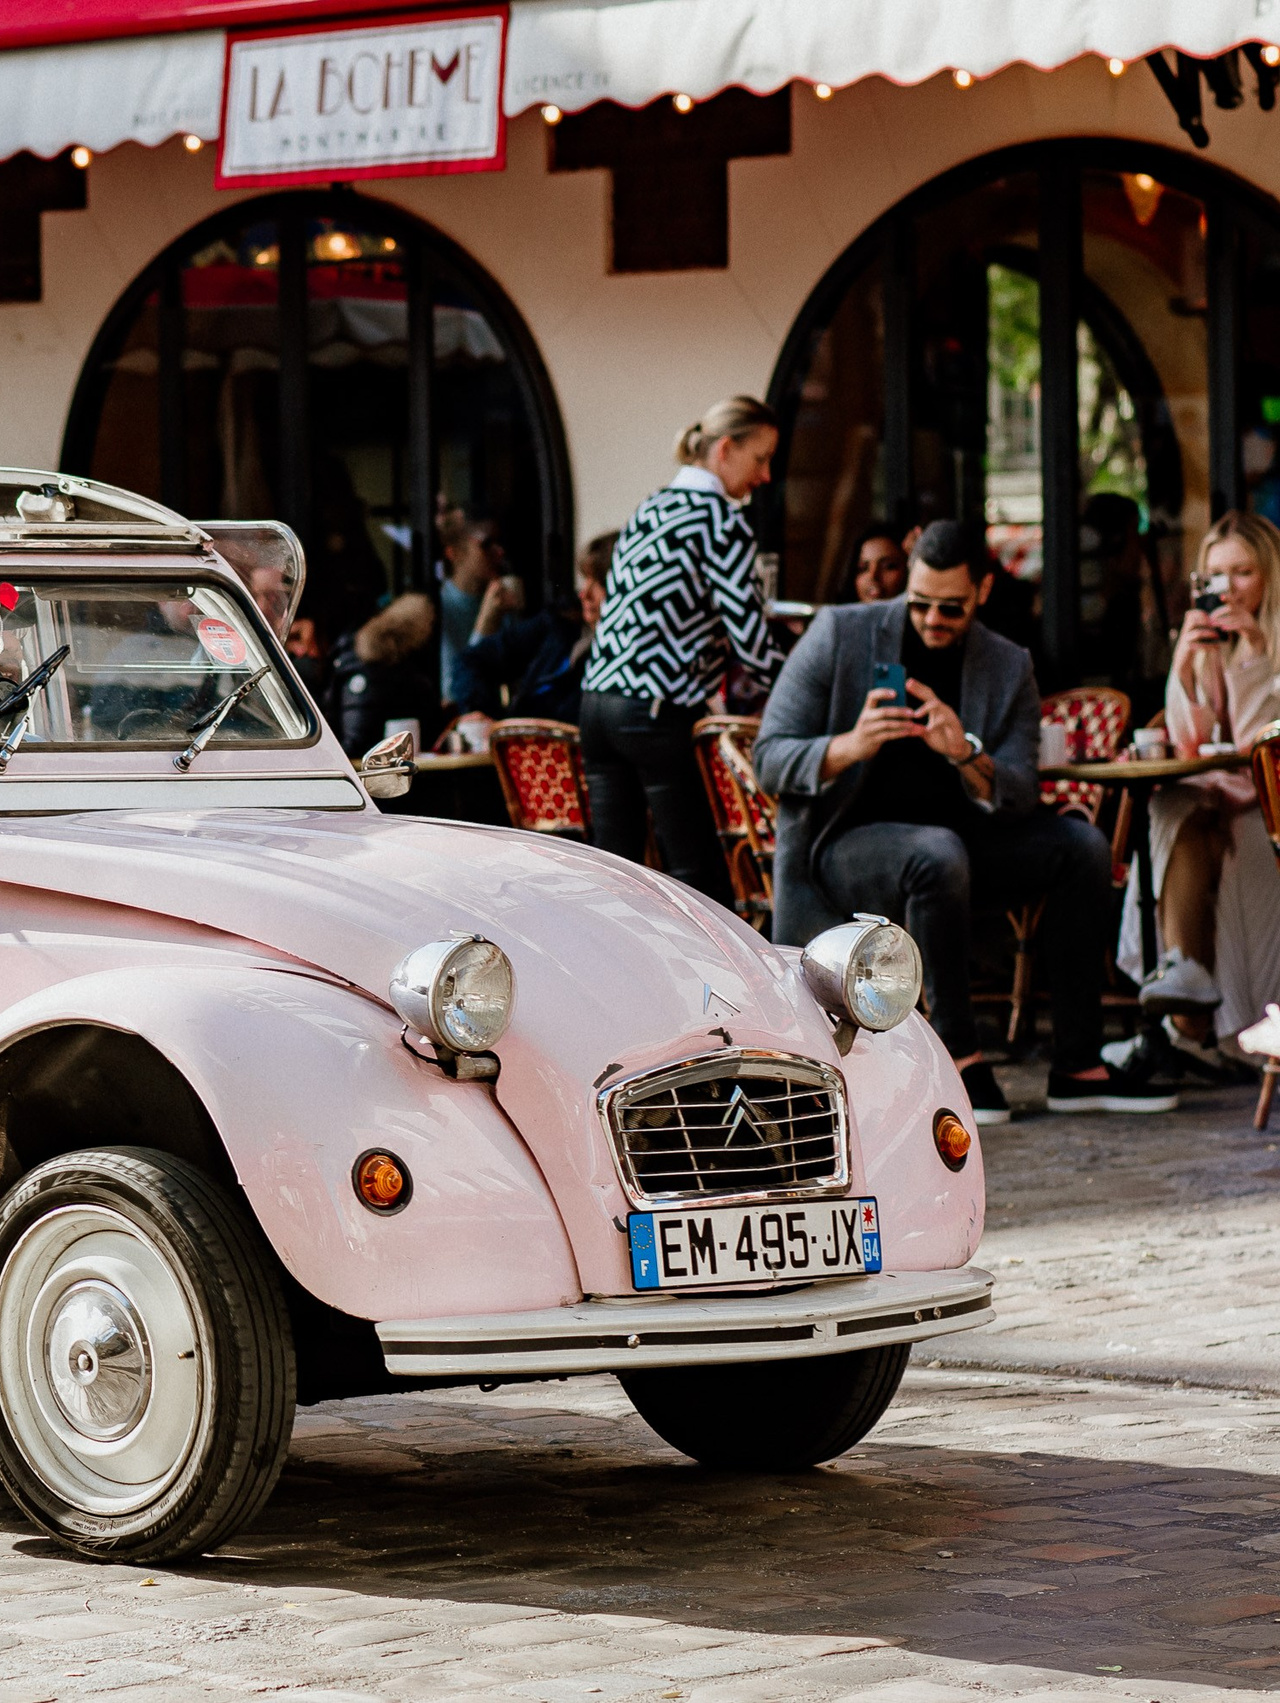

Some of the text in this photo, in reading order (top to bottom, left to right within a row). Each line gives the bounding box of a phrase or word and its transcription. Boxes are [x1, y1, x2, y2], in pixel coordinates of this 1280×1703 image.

[248, 65, 292, 122] LA
[863, 1238, 880, 1262] 94
[640, 1259, 650, 1277] F
